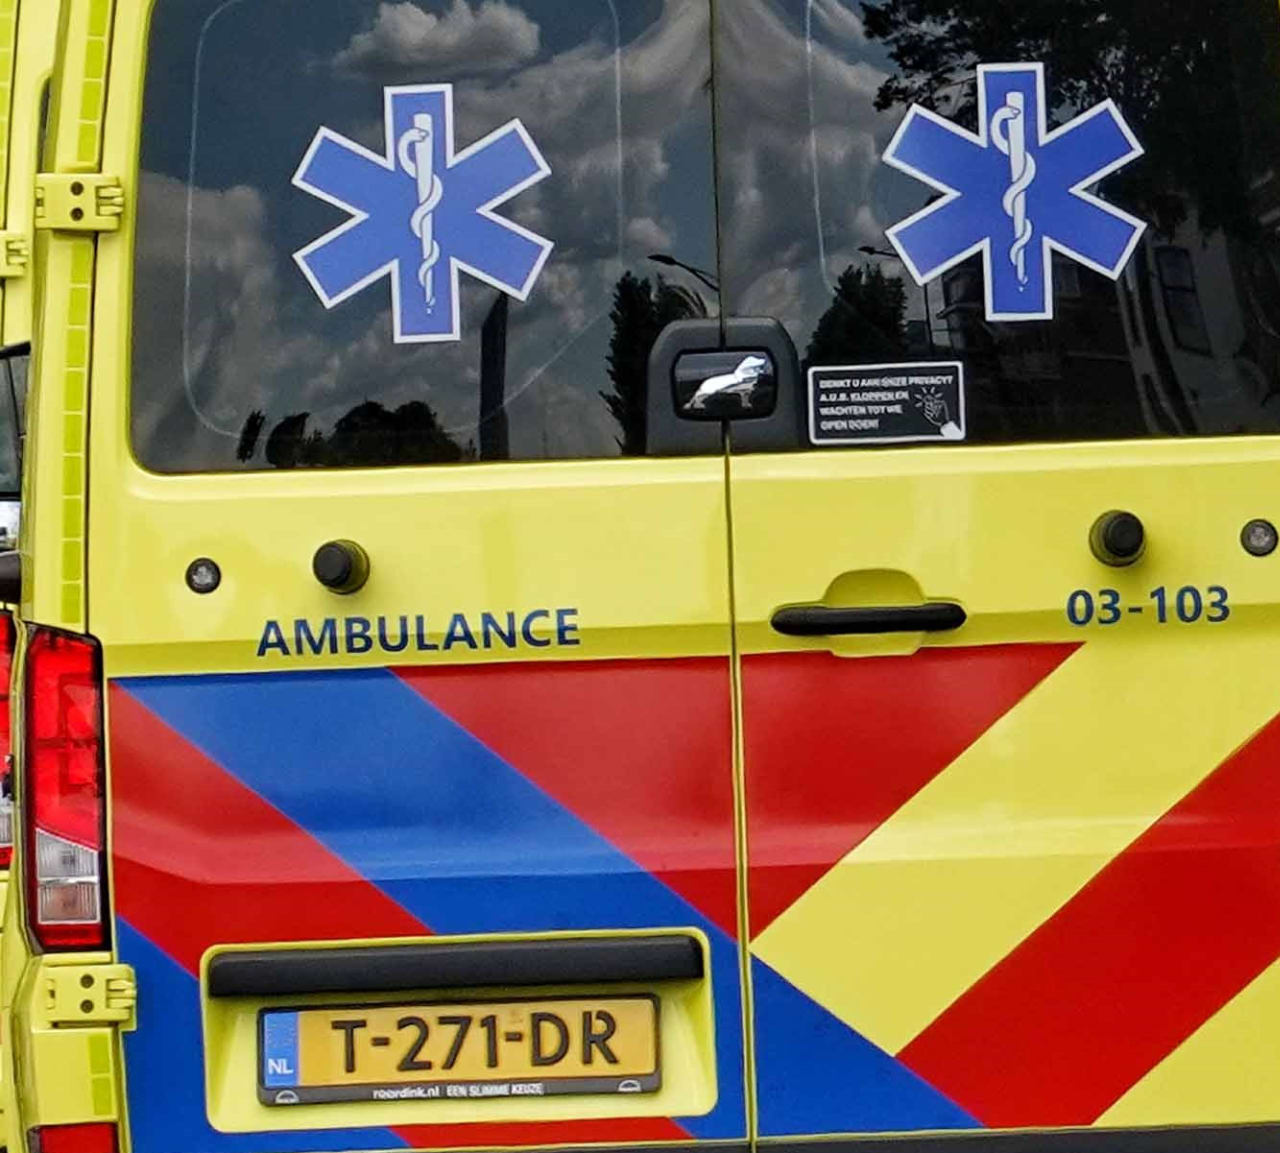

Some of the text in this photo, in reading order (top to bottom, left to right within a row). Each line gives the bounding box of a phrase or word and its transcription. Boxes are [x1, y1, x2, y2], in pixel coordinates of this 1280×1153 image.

[1066, 585, 1231, 626] 03-103
[256, 608, 581, 656] AMBULANCE
[268, 1011, 620, 1075] NL T-271-DR
